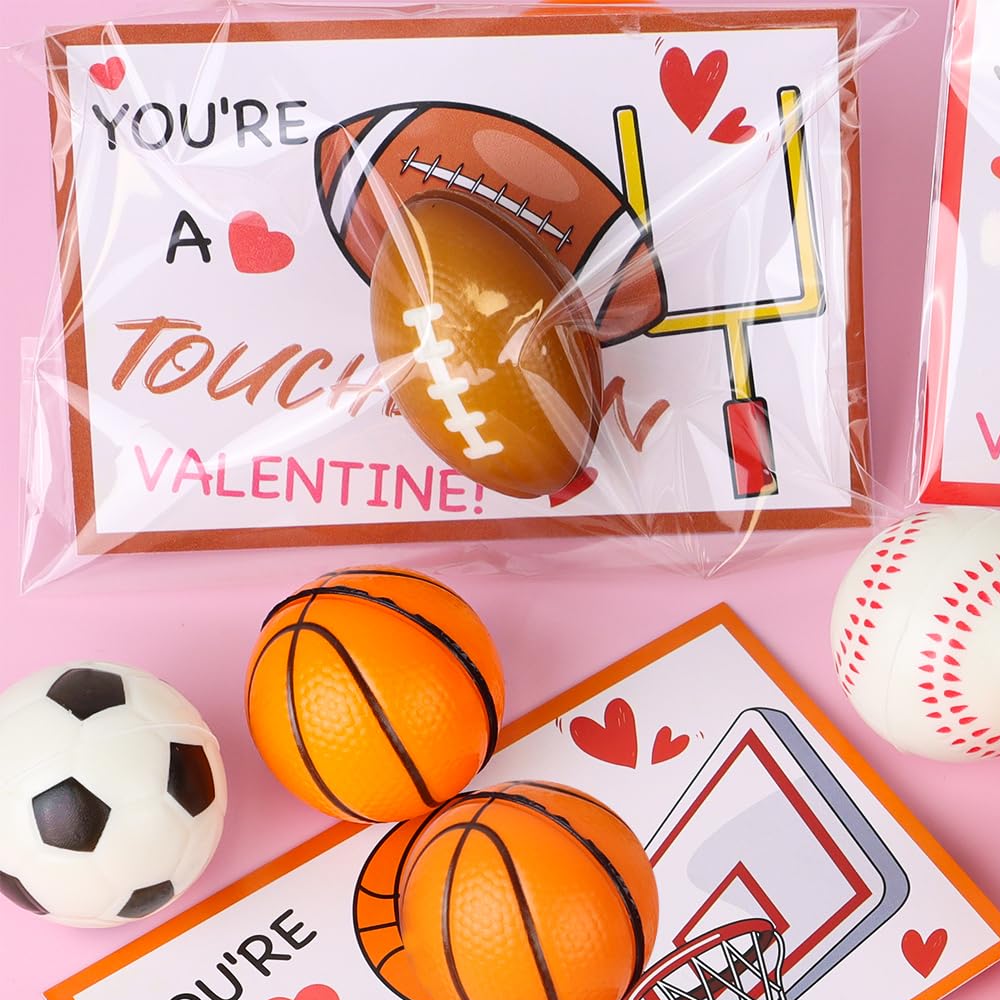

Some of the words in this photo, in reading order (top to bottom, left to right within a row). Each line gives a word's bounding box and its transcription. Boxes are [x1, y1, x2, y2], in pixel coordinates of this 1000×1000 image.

[92, 96, 308, 150] YOU'RE
[166, 210, 212, 264] A
[134, 446, 484, 515] VALENTINE!
